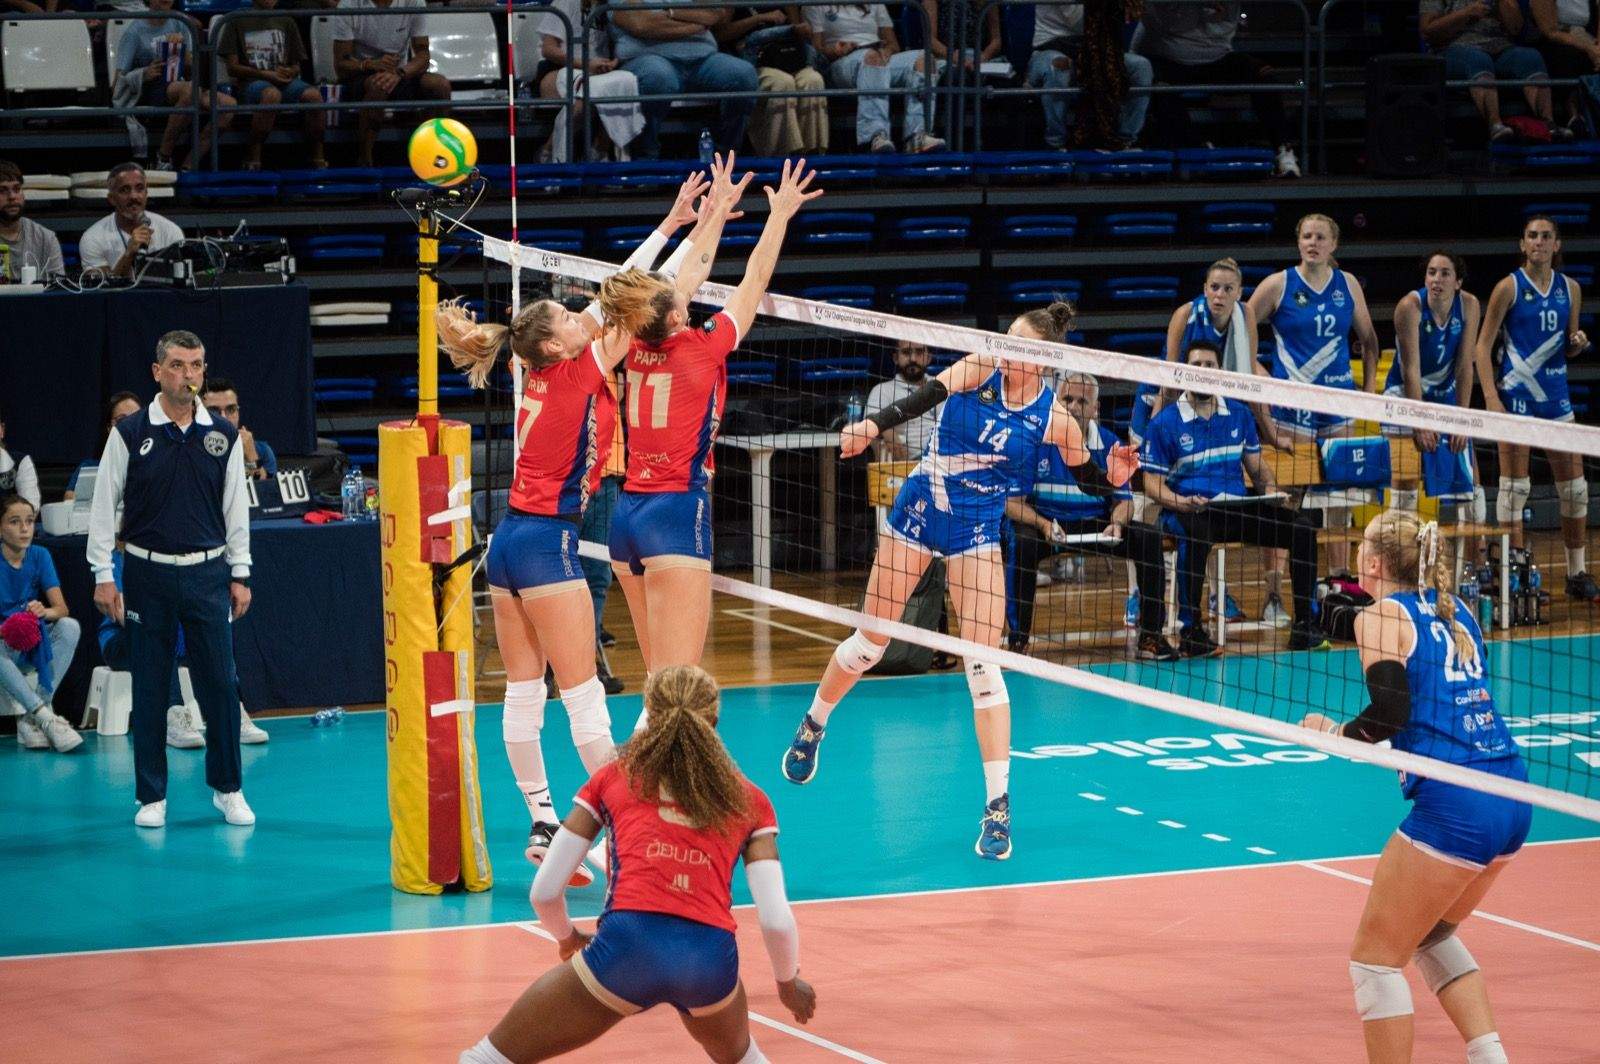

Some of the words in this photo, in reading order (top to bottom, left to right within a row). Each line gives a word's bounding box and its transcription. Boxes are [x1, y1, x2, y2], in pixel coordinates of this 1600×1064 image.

[1314, 314, 1336, 337] 12
[1539, 310, 1558, 331] 19
[634, 350, 667, 366] PAPP
[1437, 344, 1446, 364] 7
[626, 368, 672, 429] 11
[1513, 398, 1527, 414] 19
[519, 394, 544, 450] 7
[1296, 408, 1312, 426] 12
[978, 418, 1012, 453] 14
[1352, 448, 1365, 462] 12
[281, 475, 306, 499] 10
[902, 518, 921, 538] 14
